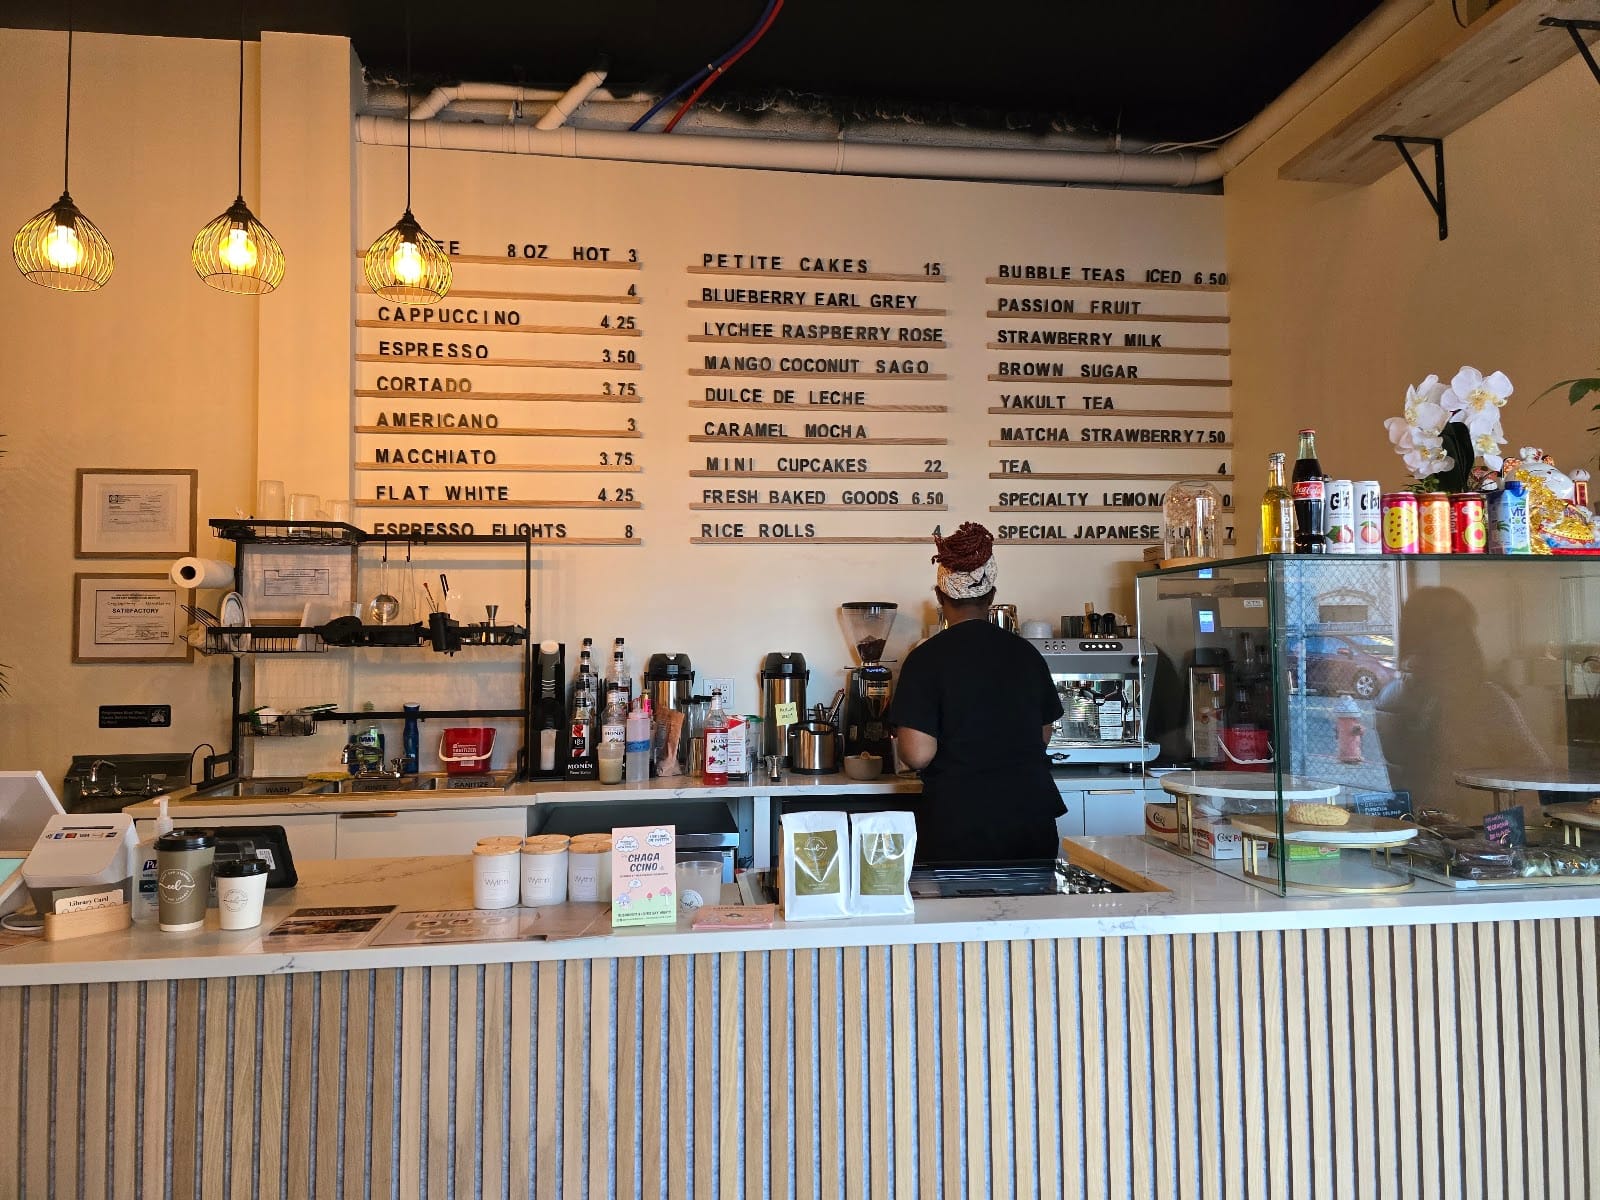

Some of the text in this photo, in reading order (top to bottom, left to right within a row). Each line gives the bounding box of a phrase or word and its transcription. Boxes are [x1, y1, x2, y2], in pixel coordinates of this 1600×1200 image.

[507, 244, 636, 262] 8 OZ HOT 3
[703, 254, 941, 276] PETITE CAKES 15
[999, 265, 1071, 280] BUBBLE
[1082, 268, 1125, 282] TEAS
[1146, 269, 1182, 284] ICED
[628, 284, 636, 297] 4
[702, 288, 917, 308] BLUEBERRY EARL GREY
[998, 298, 1141, 314] PASSION FRUIT
[378, 307, 635, 329] CAPPUCCINO 4.25
[704, 322, 943, 342] LYCHEE RASPBERRY ROSE
[998, 330, 1162, 347] STRAWBERRY MILK
[379, 341, 635, 364] ESPRESSO 3.50
[704, 356, 929, 374] MANGO COCONUT SAGO
[999, 362, 1138, 378] BROWN SUGAR
[376, 376, 636, 396] CORTADO 3.75
[705, 388, 865, 405] DULCE DE LECHE
[1000, 395, 1114, 410] YAKULT TEA
[376, 412, 636, 432] AMERICANO 3
[704, 422, 867, 438] CARAMEL MOCHA
[1000, 427, 1226, 443] MATCHA STRAWBERRY 7.50
[376, 449, 632, 465] MACCHIATO 3.75
[706, 457, 942, 473] MINI CUPCAKES 22
[1000, 460, 1226, 475] TEA 4
[376, 485, 633, 502] FLAT WHITE 4.25
[703, 489, 944, 505] FRESH BAKED GOODS 6.50
[999, 493, 1165, 507] SPECIALTY LEMON
[373, 523, 633, 538] ESPRESSO FLIGHTS 8
[701, 523, 942, 538] RICE ROLLS 4
[998, 525, 1066, 539] SPECIAL
[1074, 525, 1159, 539] JAPANESE
[1225, 527, 1234, 539] 7
[567, 762, 593, 770] MONIN
[265, 785, 290, 793] WASH
[628, 852, 660, 863] CHAGA
[630, 862, 658, 872] CCINO
[69, 896, 109, 907] Library Card
